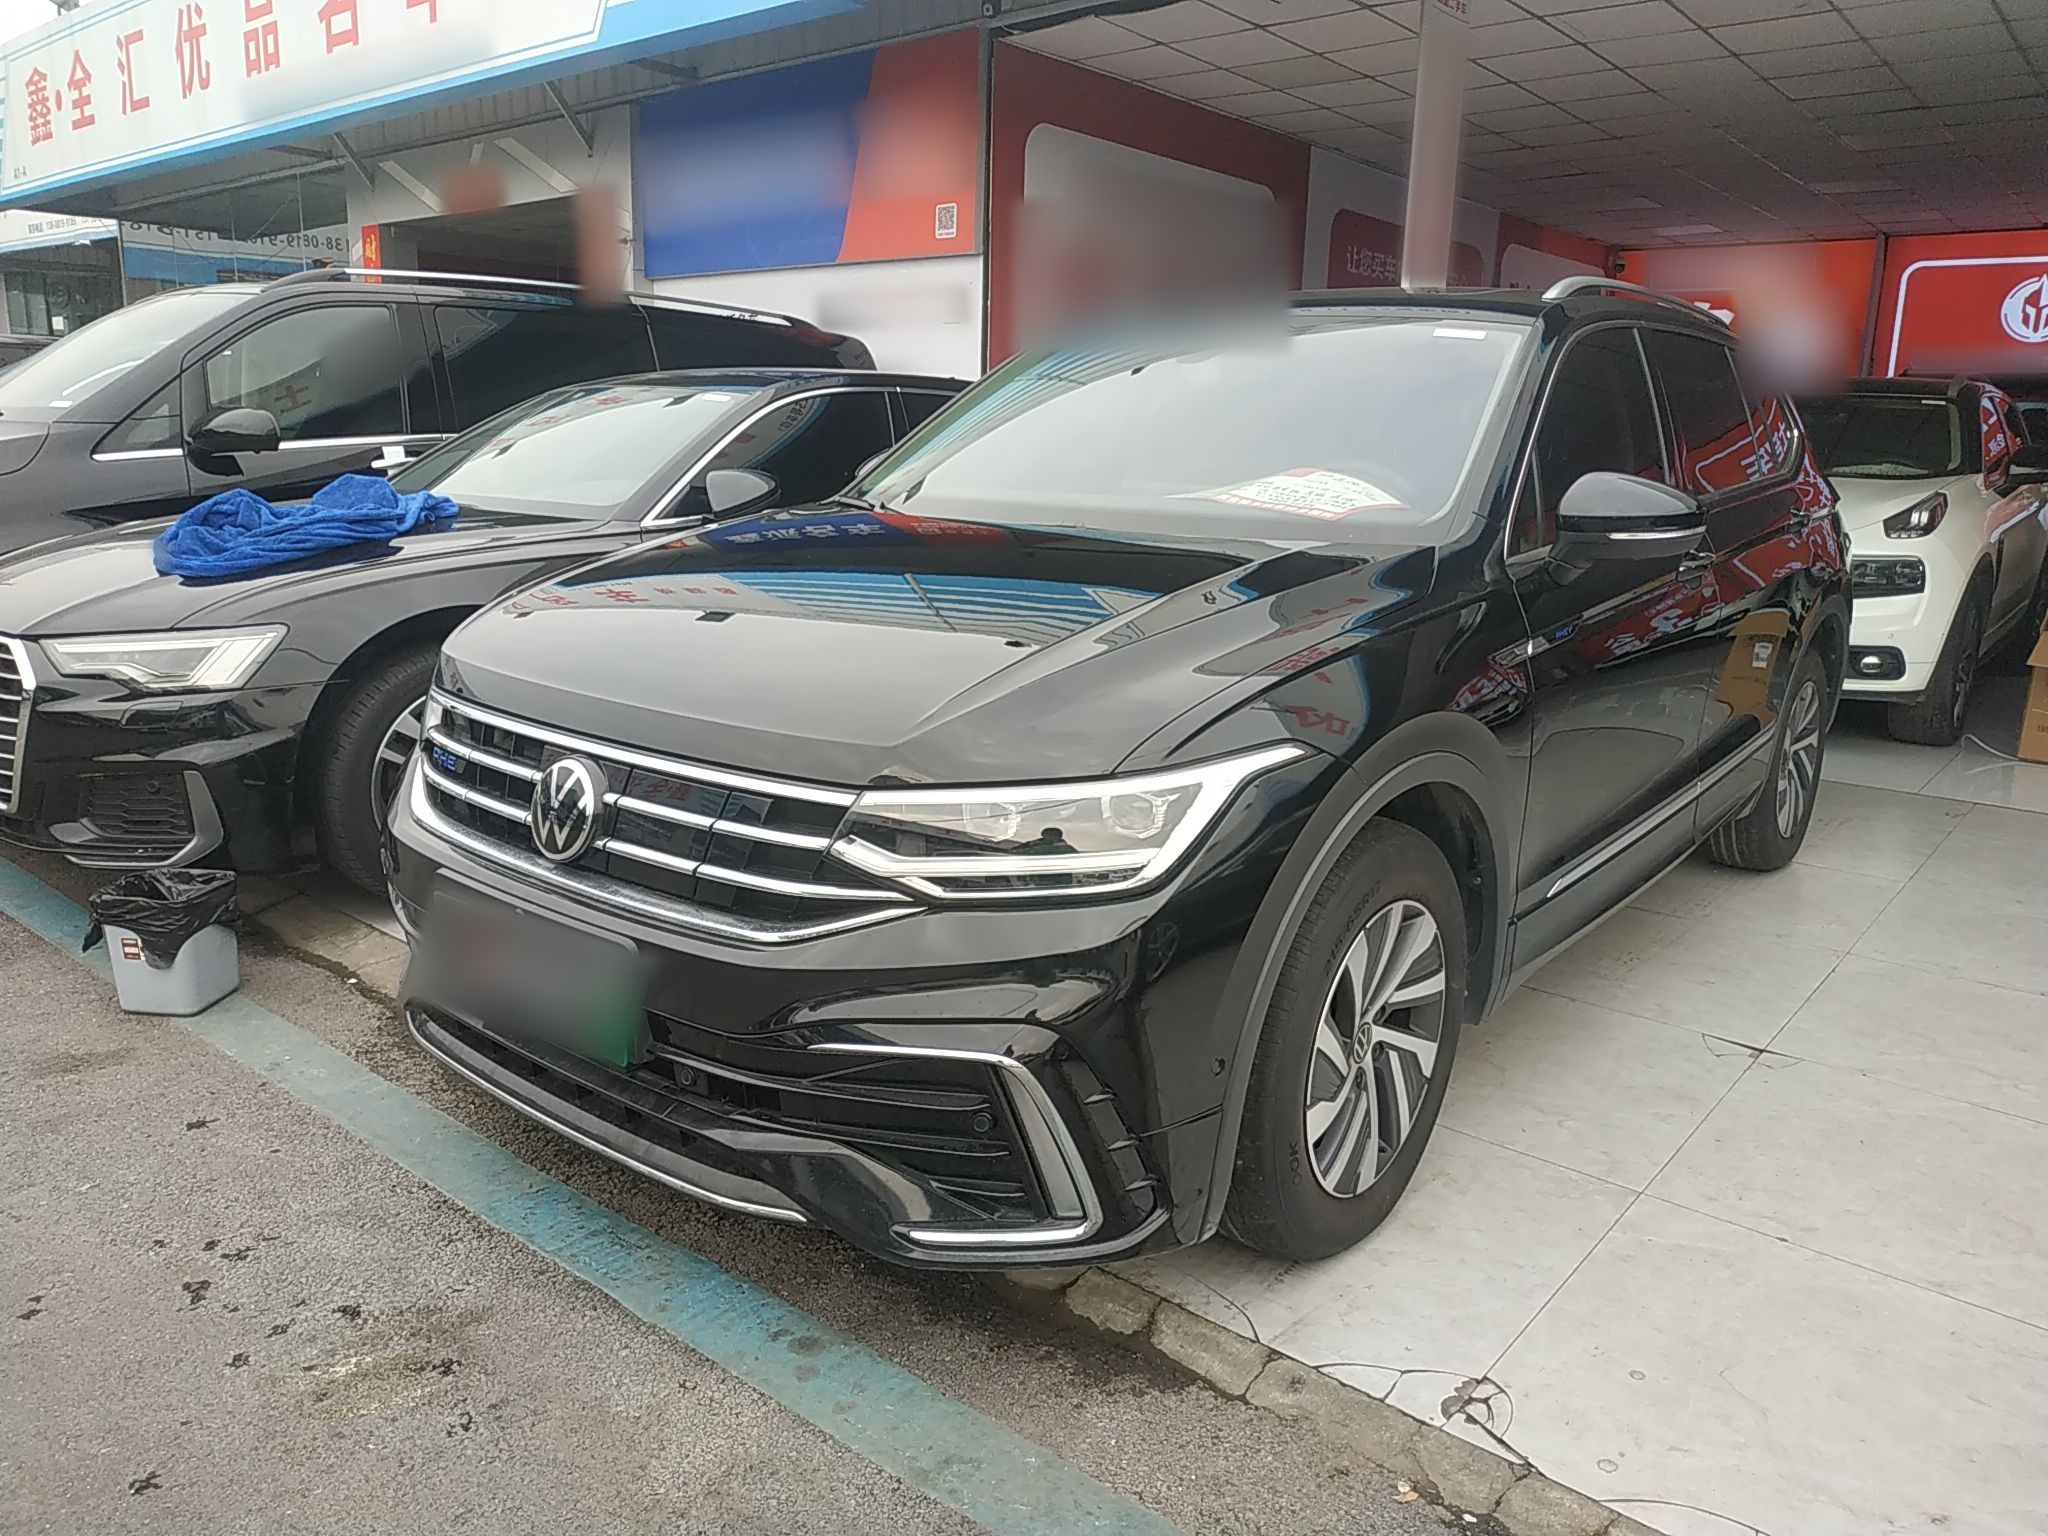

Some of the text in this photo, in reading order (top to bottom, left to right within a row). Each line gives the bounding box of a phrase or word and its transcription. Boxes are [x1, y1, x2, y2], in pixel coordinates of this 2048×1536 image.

[24, 0, 438, 146] 鑫·全汇优品名
[1346, 245, 1401, 281] 让您买车
